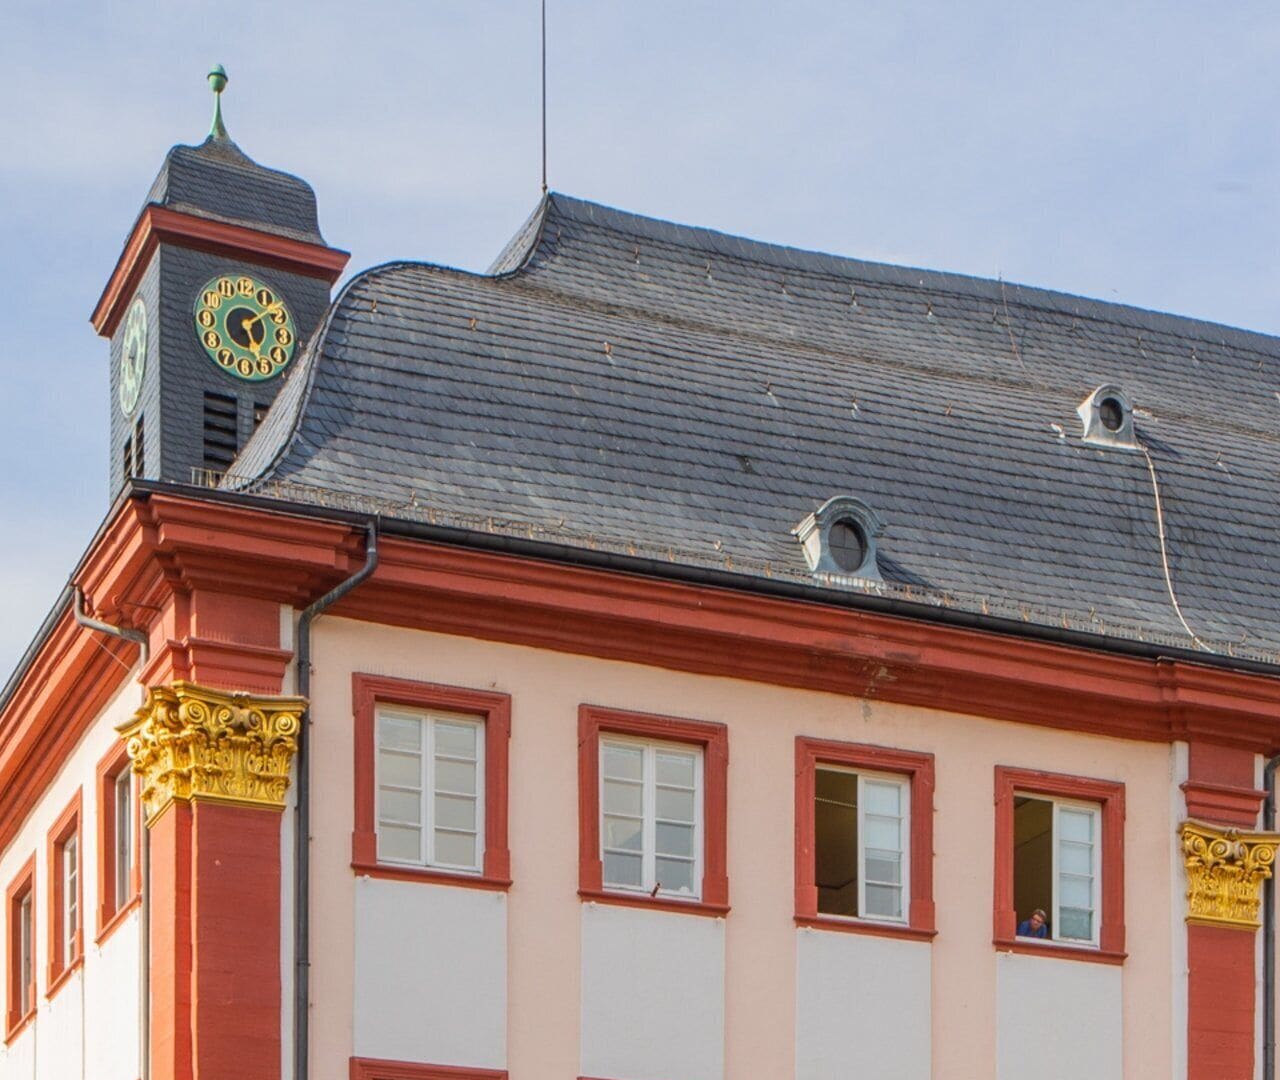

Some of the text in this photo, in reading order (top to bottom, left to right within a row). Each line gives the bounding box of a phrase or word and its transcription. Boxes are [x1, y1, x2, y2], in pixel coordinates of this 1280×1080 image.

[221, 280, 232, 297] 11
[239, 279, 254, 296] 12
[207, 292, 219, 309] 10
[262, 290, 268, 306] 1
[202, 313, 211, 327] 9
[275, 309, 283, 323] 2
[207, 332, 217, 348] 8
[279, 327, 288, 345] 3
[222, 350, 231, 365] 7
[273, 347, 282, 362] 4
[241, 359, 250, 376] 6
[261, 359, 269, 376] 5
